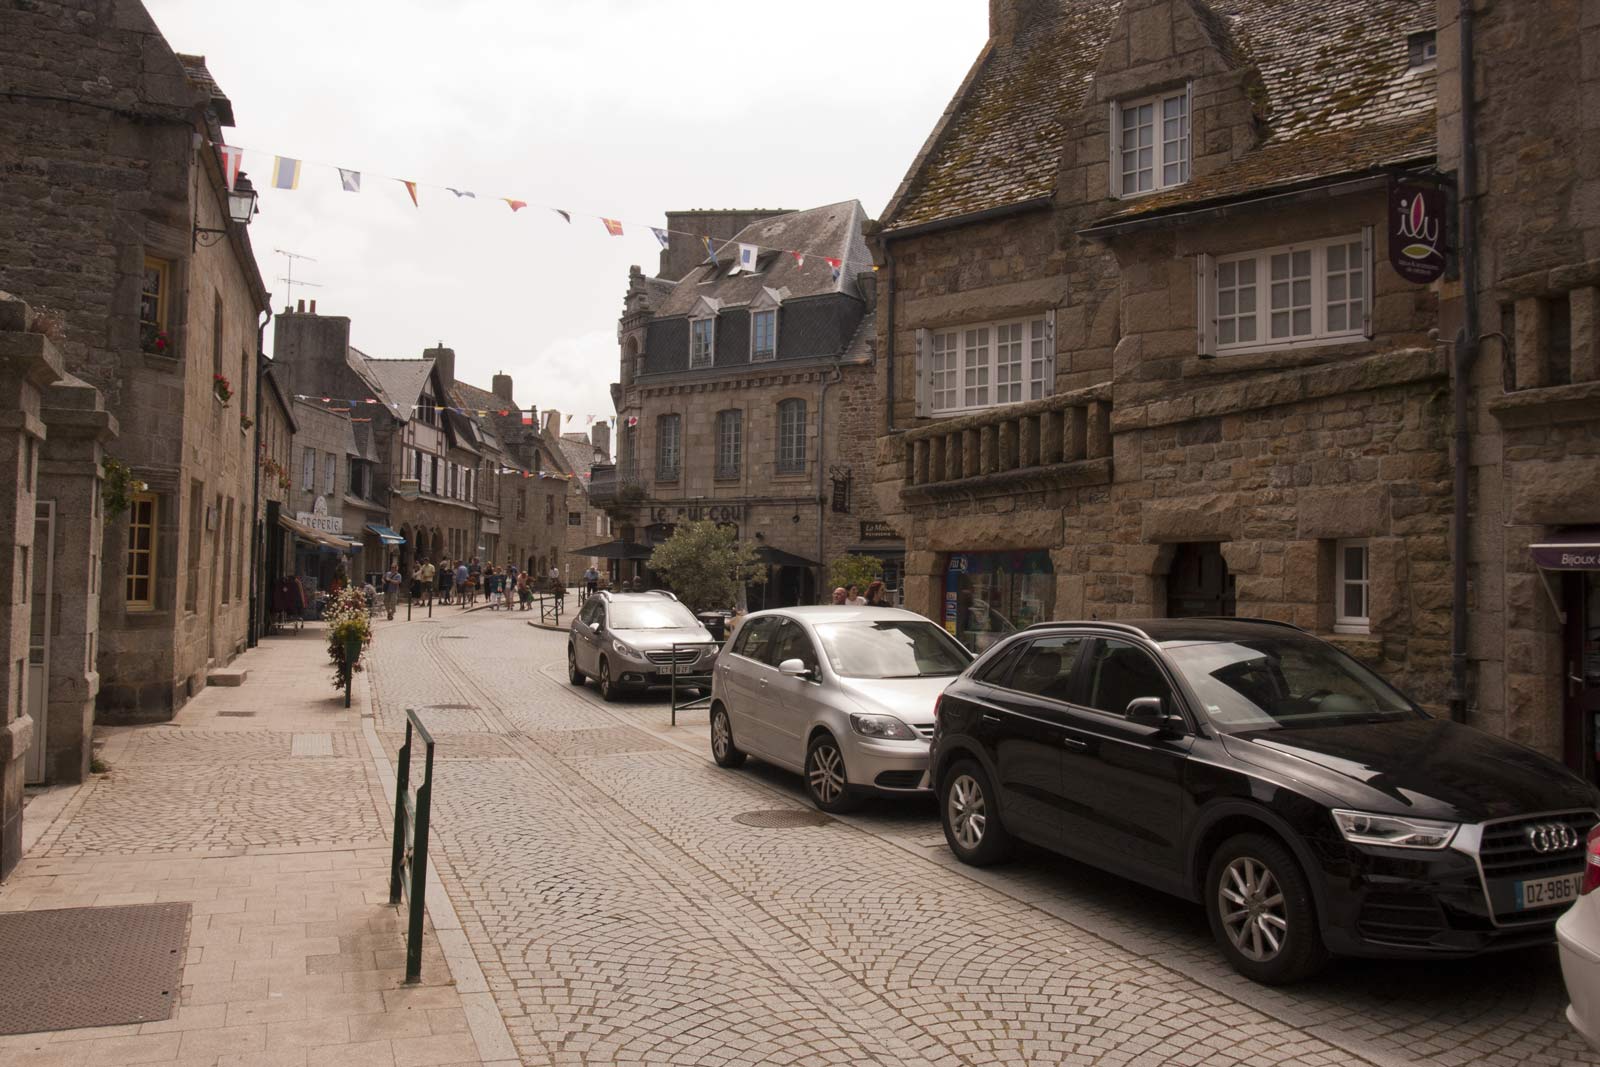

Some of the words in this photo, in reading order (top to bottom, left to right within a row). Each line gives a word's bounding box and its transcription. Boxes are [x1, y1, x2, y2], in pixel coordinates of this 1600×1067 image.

[1396, 192, 1443, 260] ily
[1561, 553, 1596, 566] Bijoux
[1526, 876, 1585, 903] DZ-986-V
